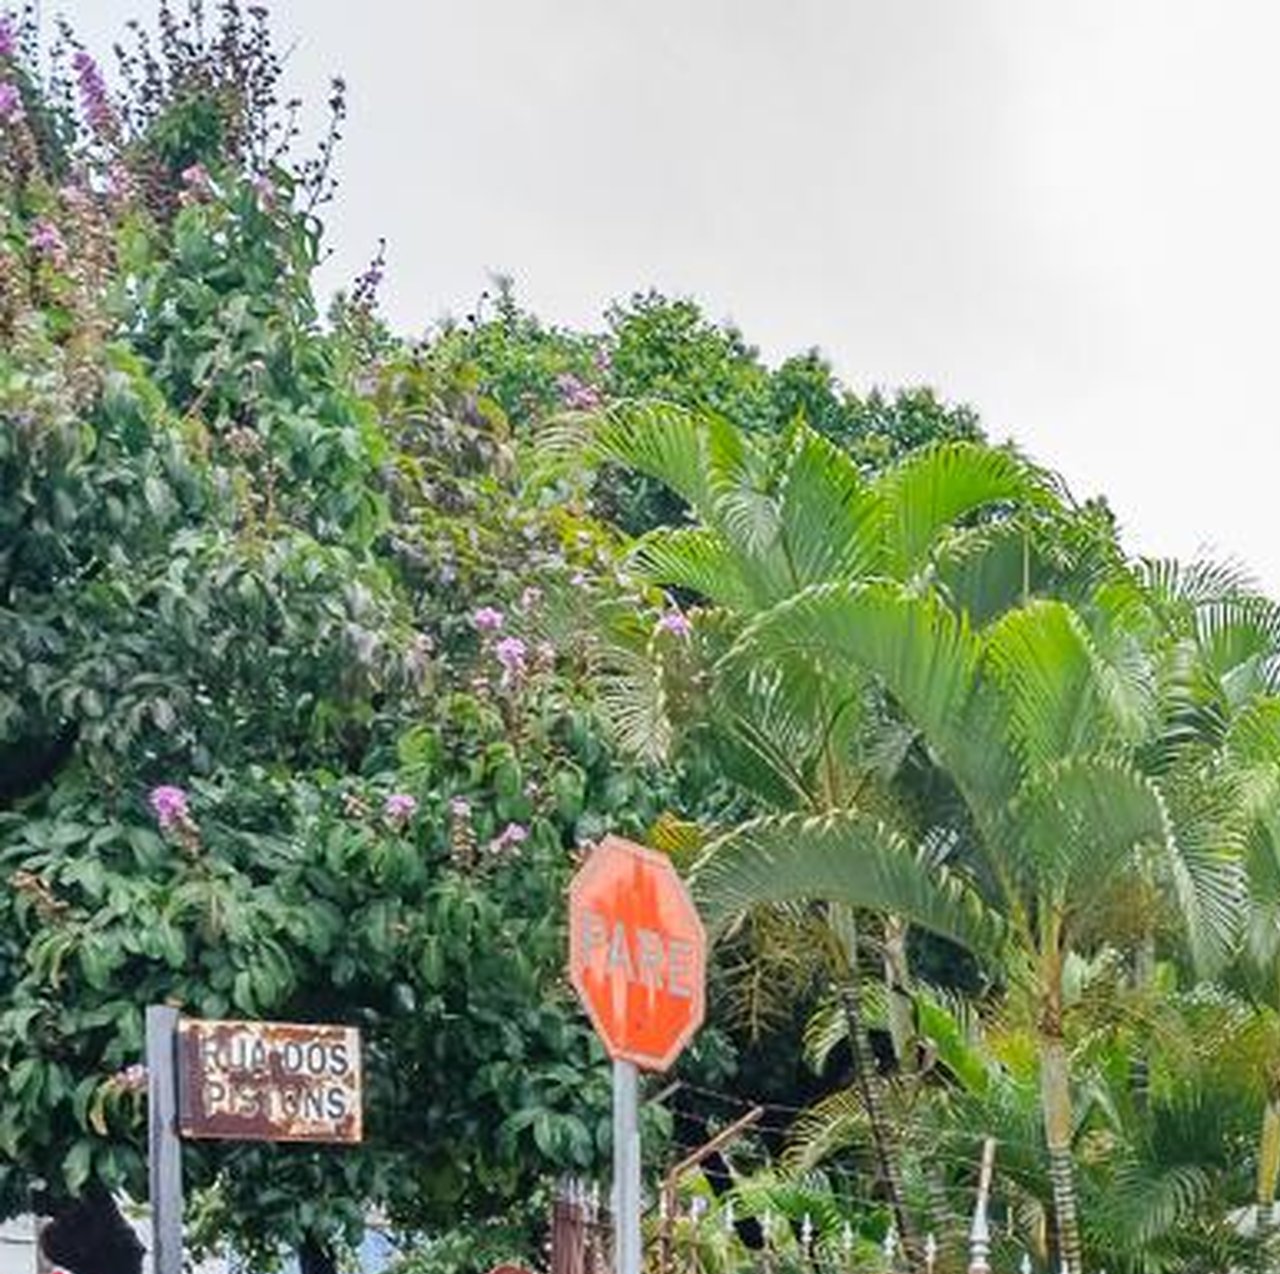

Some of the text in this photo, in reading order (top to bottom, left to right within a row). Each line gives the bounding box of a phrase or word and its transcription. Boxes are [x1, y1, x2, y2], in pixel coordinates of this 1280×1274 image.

[582, 907, 692, 999] PARE
[202, 1038, 349, 1076] RUA DOS
